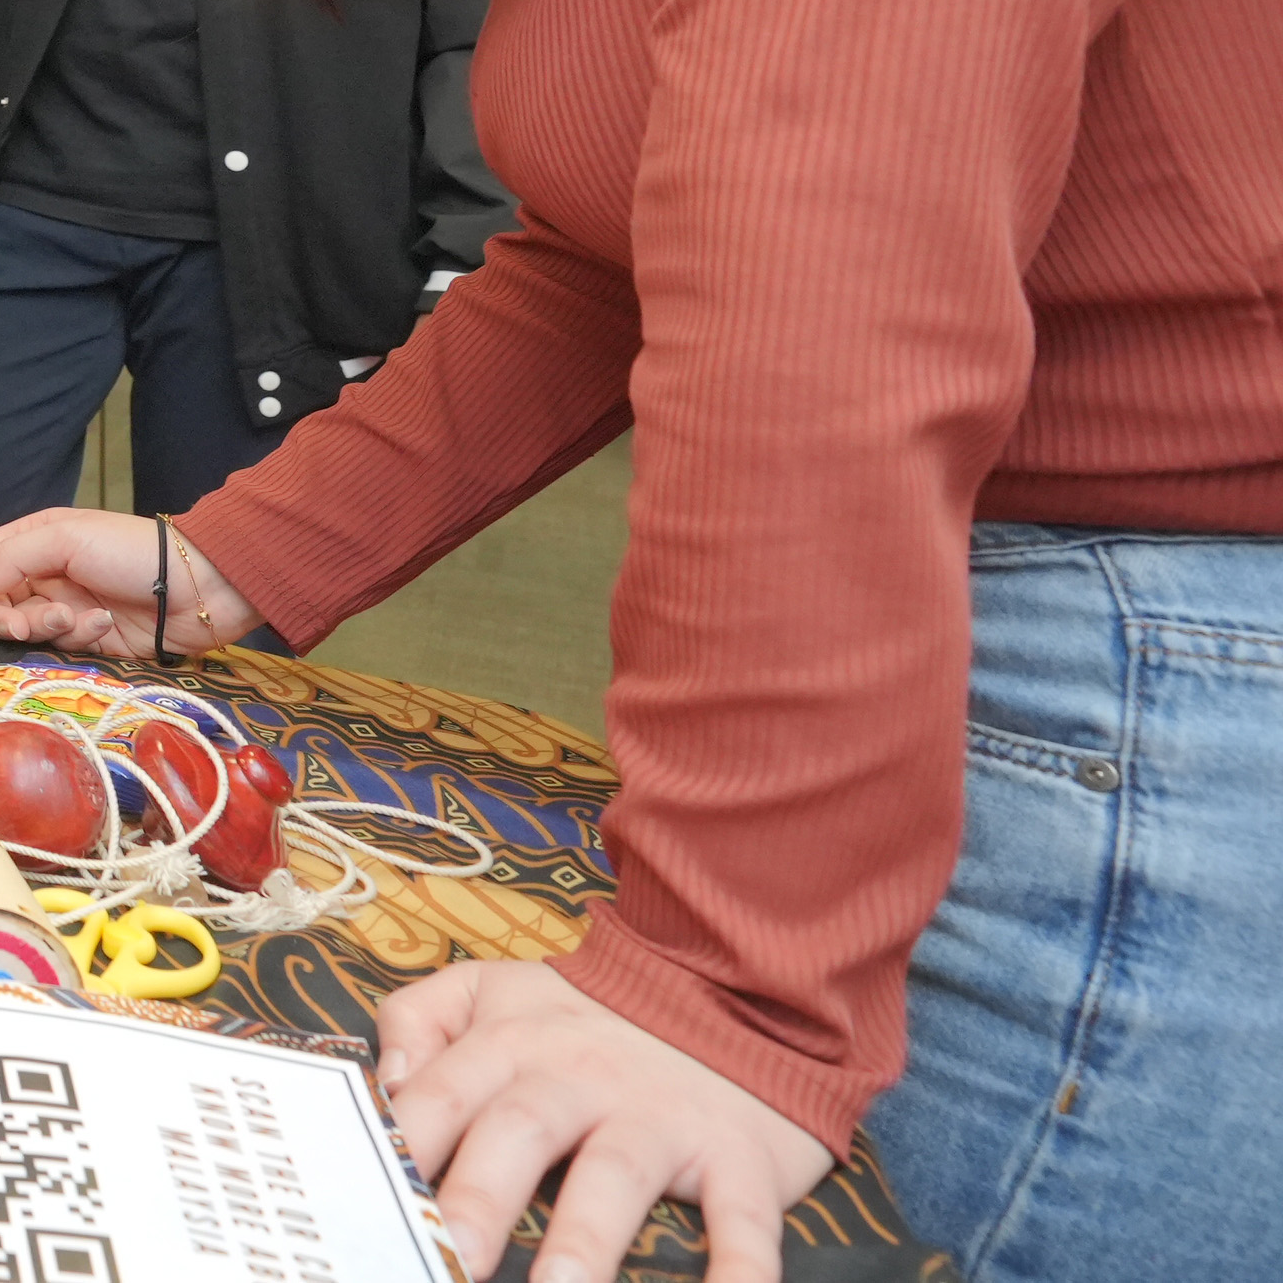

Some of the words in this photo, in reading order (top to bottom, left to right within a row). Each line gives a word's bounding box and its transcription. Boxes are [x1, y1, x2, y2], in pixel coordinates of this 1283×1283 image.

[189, 1082, 243, 1155] KNOW
[230, 1076, 285, 1140] SCAN
[157, 1125, 230, 1256] MALAYSIA
[214, 1161, 271, 1234] MORE
[255, 1150, 306, 1199] THE
